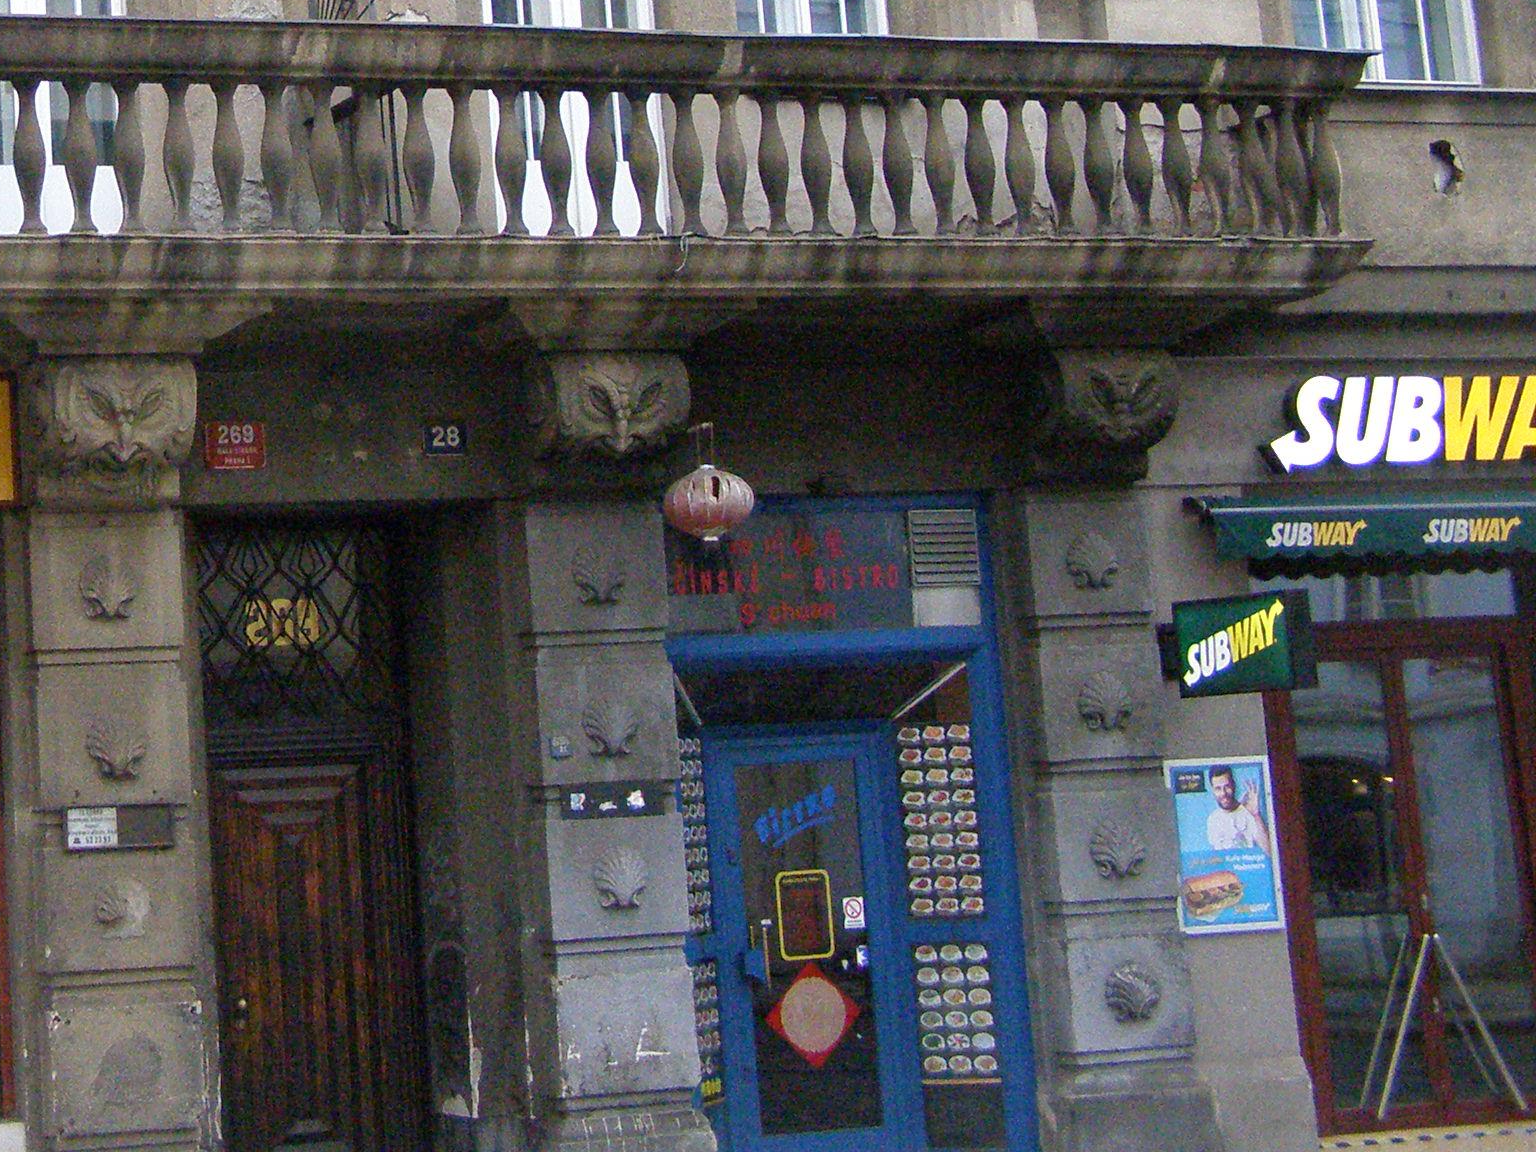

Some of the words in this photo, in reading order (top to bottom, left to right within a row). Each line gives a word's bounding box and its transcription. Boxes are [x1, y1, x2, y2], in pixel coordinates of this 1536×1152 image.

[218, 424, 254, 444] 269
[432, 426, 460, 446] 28
[1266, 519, 1367, 548] SUBWAY
[1423, 517, 1521, 544] SUBWAY
[1183, 599, 1284, 687] SUBWAY
